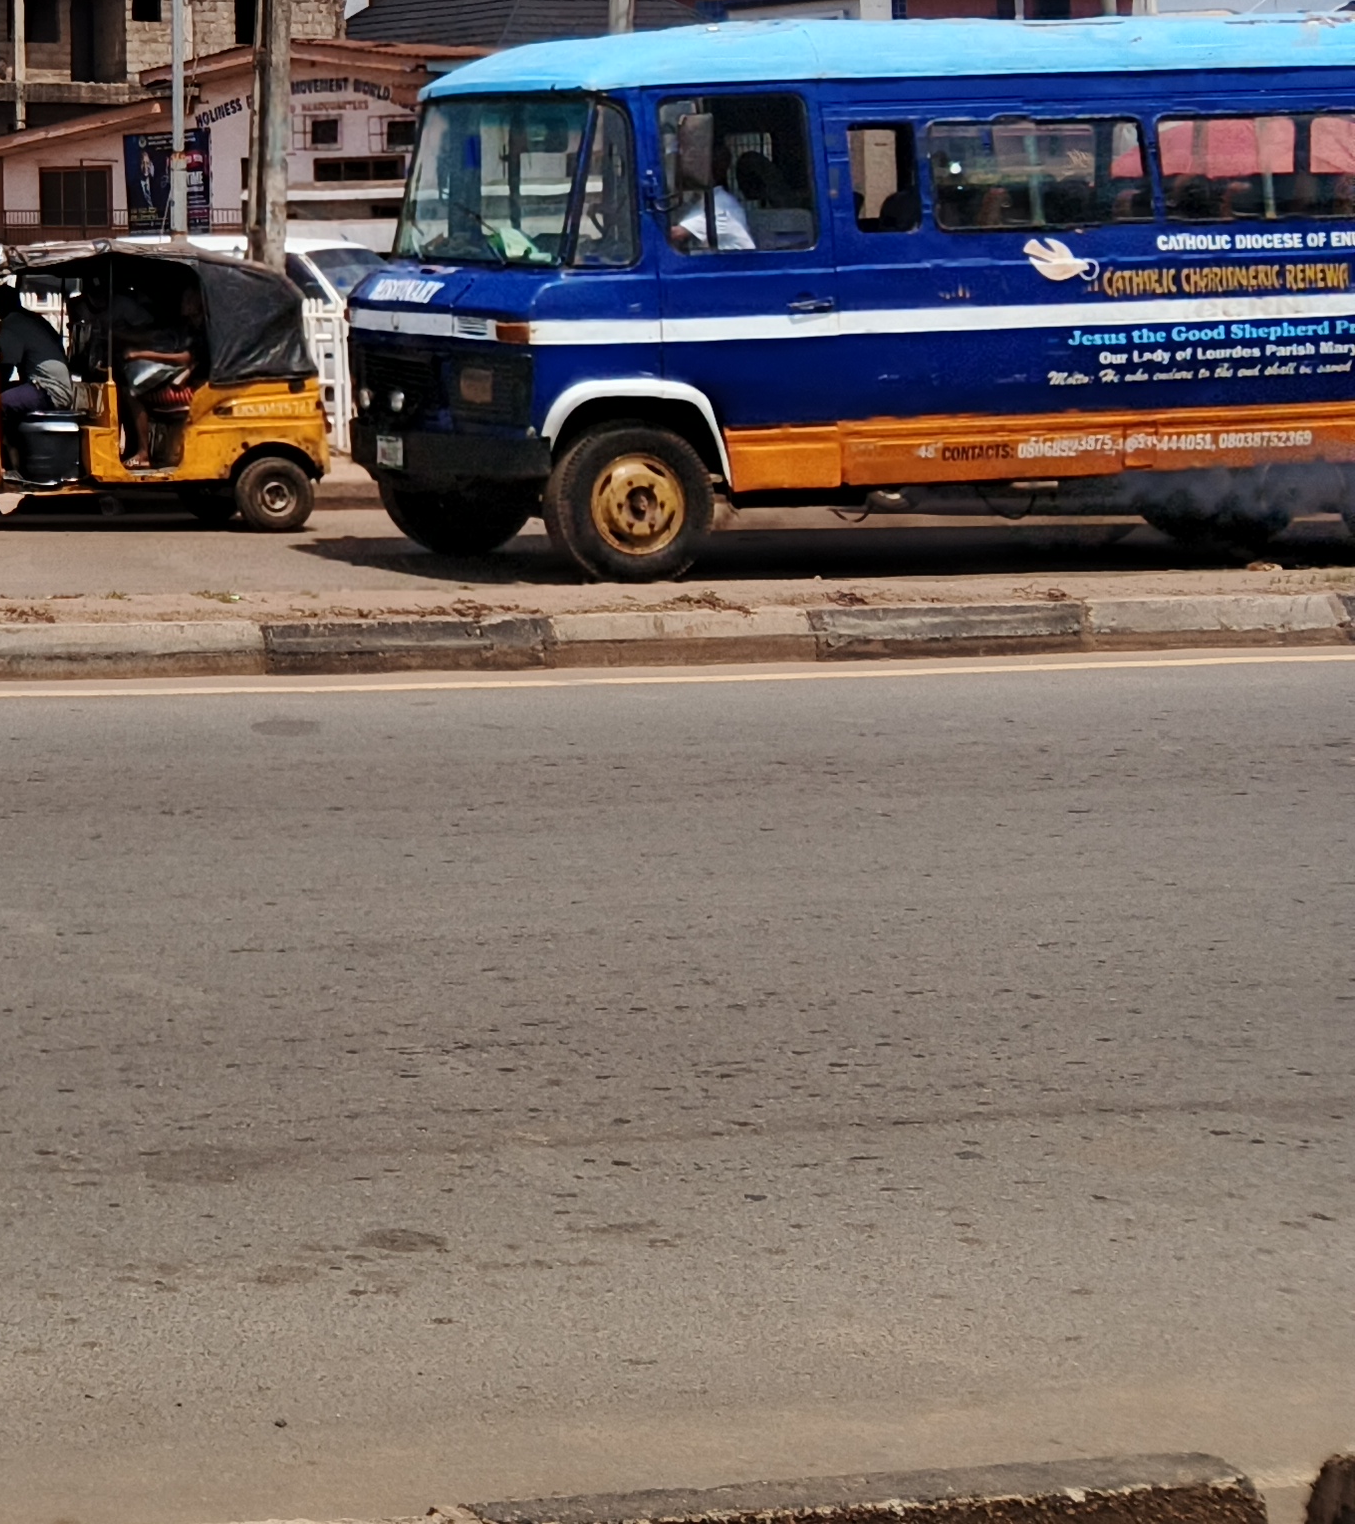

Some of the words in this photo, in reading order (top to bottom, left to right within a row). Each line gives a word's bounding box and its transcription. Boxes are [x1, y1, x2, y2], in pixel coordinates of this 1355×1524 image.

[195, 94, 243, 127] HOLINESS
[1156, 233, 1232, 251] CATHOLIC
[1234, 232, 1303, 250] DIOCESE
[1306, 232, 1327, 248] OF
[1330, 231, 1355, 247] EN
[1067, 330, 1127, 346] Jesus
[1131, 328, 1167, 344] the
[1171, 325, 1226, 342] Good
[1230, 320, 1330, 341] Shepherd
[1098, 351, 1129, 365] Our
[1132, 348, 1172, 364] Lady
[1175, 347, 1193, 361] of
[1196, 345, 1261, 361] Lourdes
[1265, 342, 1316, 357] Parish
[942, 443, 1015, 462] CONTACTS:
